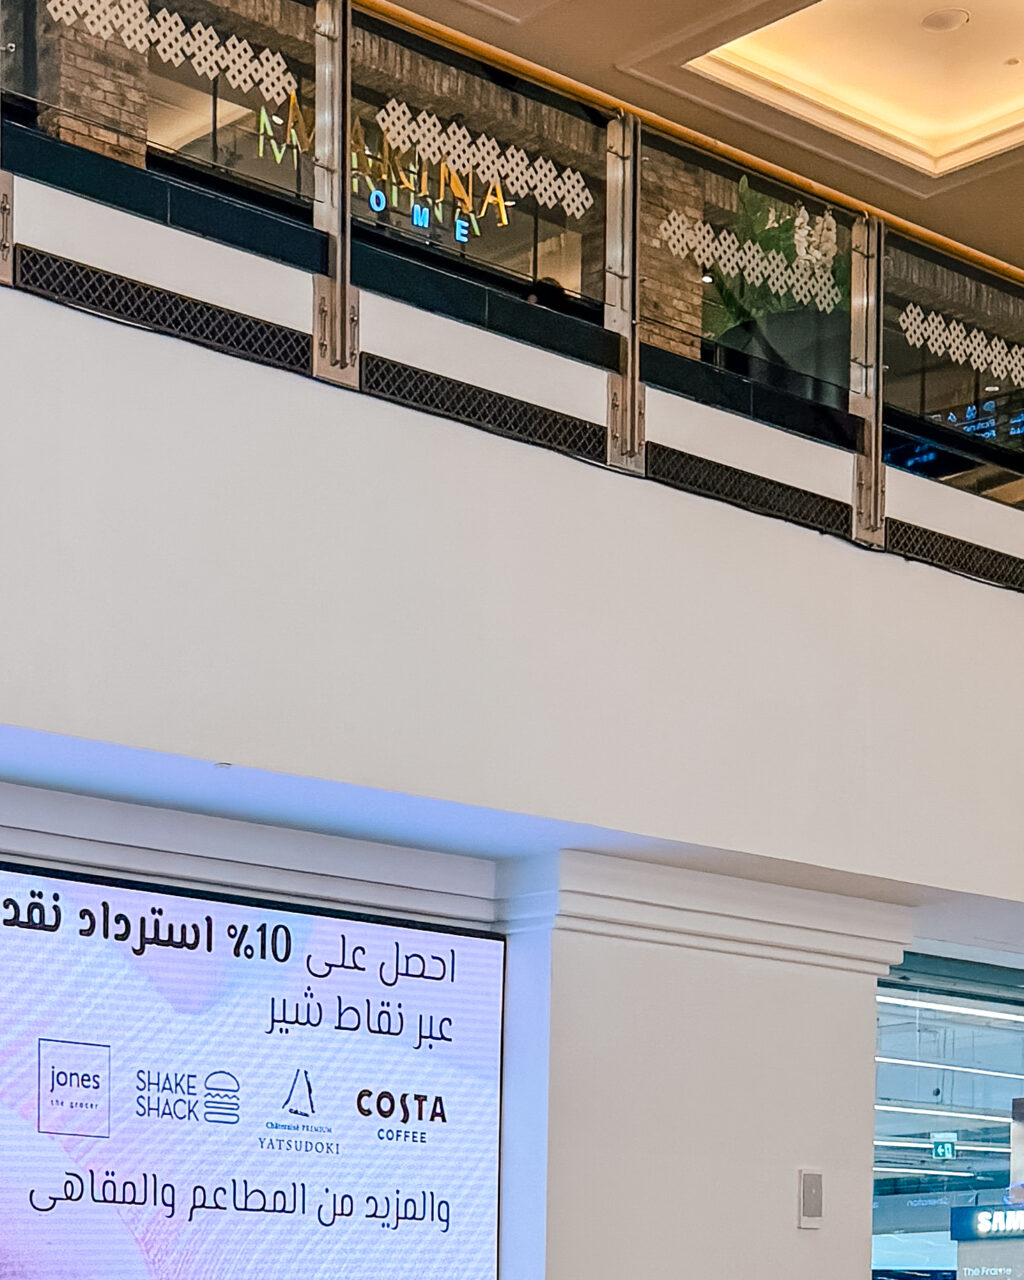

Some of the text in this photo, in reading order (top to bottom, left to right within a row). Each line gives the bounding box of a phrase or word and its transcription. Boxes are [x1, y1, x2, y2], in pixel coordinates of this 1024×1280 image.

[79, 901, 212, 956] استرداد
[379, 941, 455, 987] احصل
[264, 986, 453, 1050] عبر نقاط شير
[50, 1065, 101, 1093] jones
[135, 1069, 197, 1096] SHAKE
[50, 1098, 99, 1110] the grocer
[135, 1094, 199, 1122] SHACK
[356, 1088, 448, 1124] COSTA
[258, 1137, 340, 1155] YATSUDOKI
[377, 1128, 427, 1144] COFFEE
[188, 1179, 306, 1222] المطاعم
[317, 1187, 354, 1227] من
[365, 1189, 450, 1233] والمزيد
